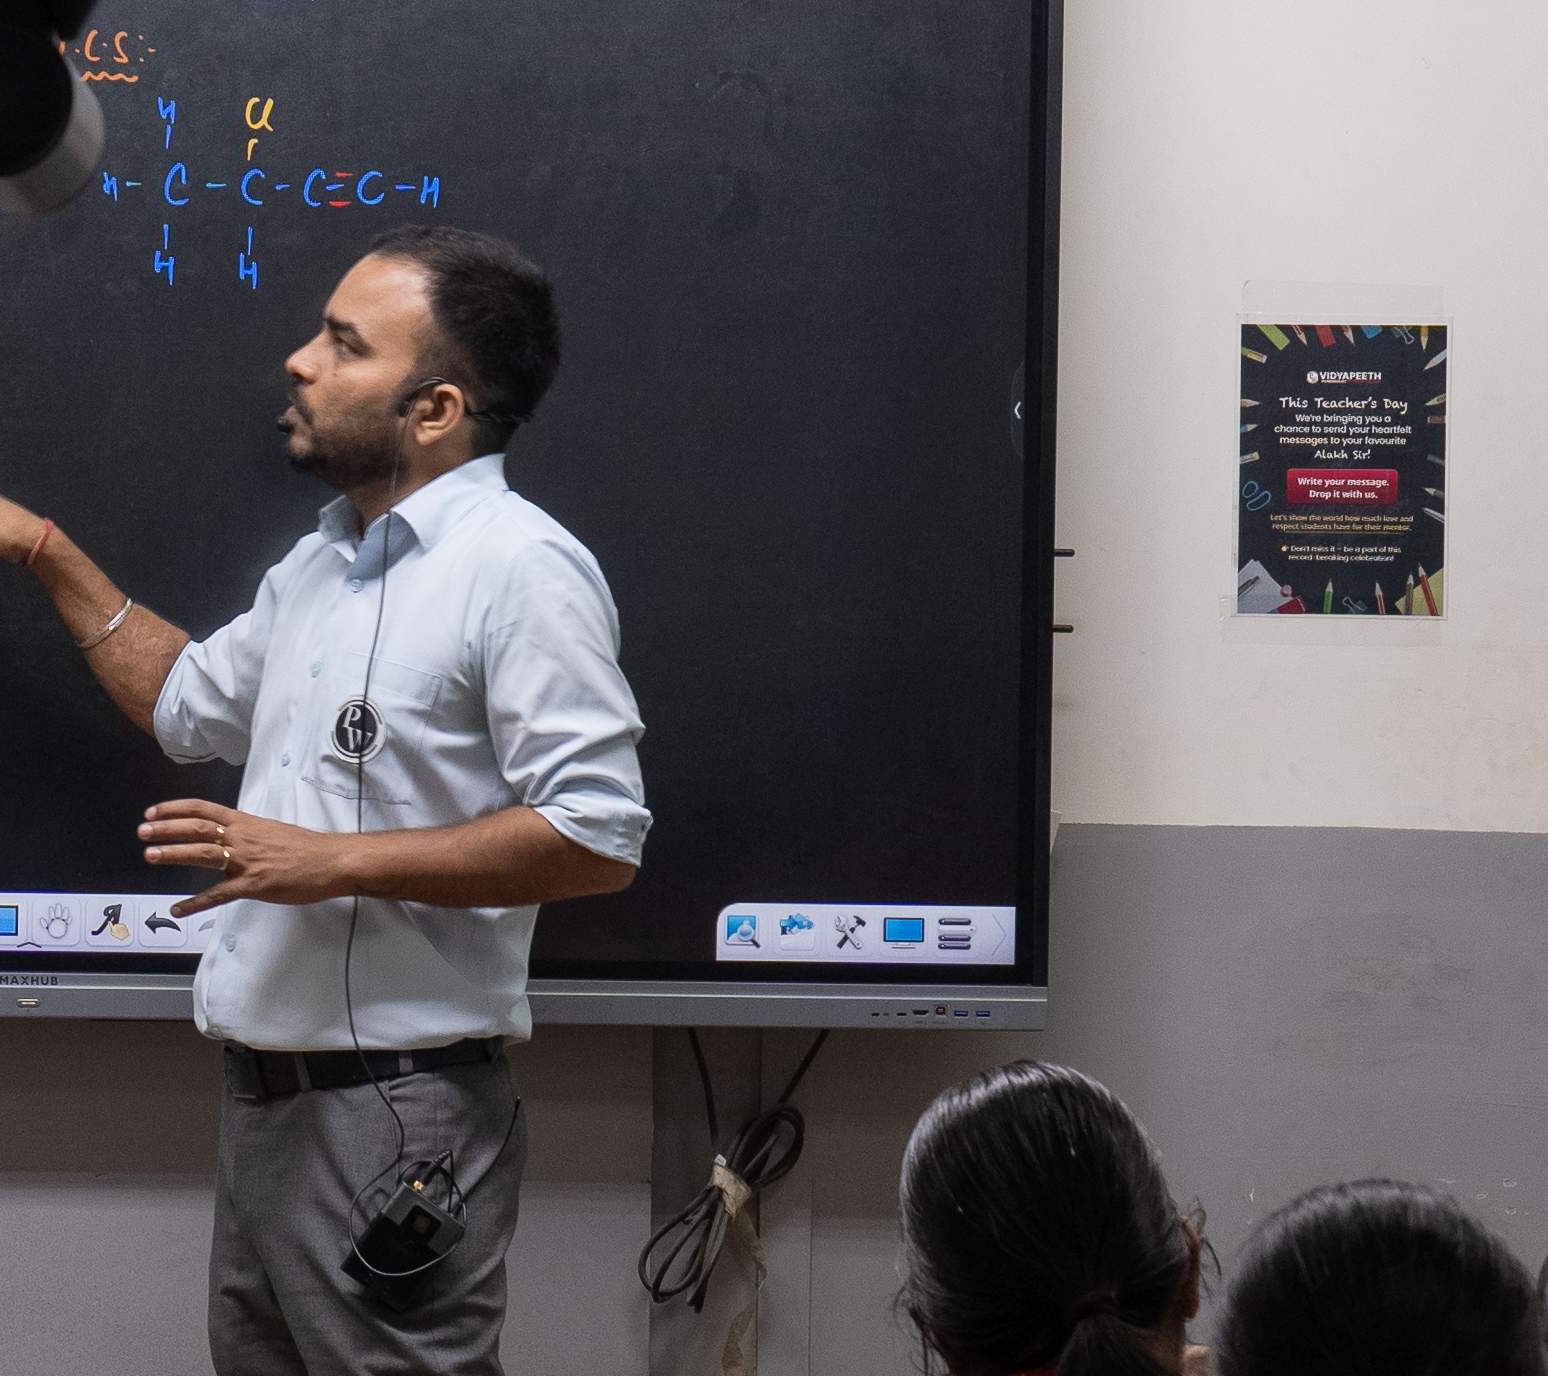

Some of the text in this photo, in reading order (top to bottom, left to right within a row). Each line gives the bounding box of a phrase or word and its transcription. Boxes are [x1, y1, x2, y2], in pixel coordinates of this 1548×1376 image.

[1319, 371, 1382, 381] VIDYAPEETH
[1278, 396, 1408, 415] This Teacher's Day
[1295, 413, 1391, 425] We're bringing you a
[1274, 424, 1412, 435] chance to send your heartfelt
[1279, 435, 1406, 447] messages to your favourite
[1314, 448, 1371, 460] Alakh Sir!
[1297, 476, 1389, 488] Write your message.
[1309, 489, 1378, 500] Drop it with us.
